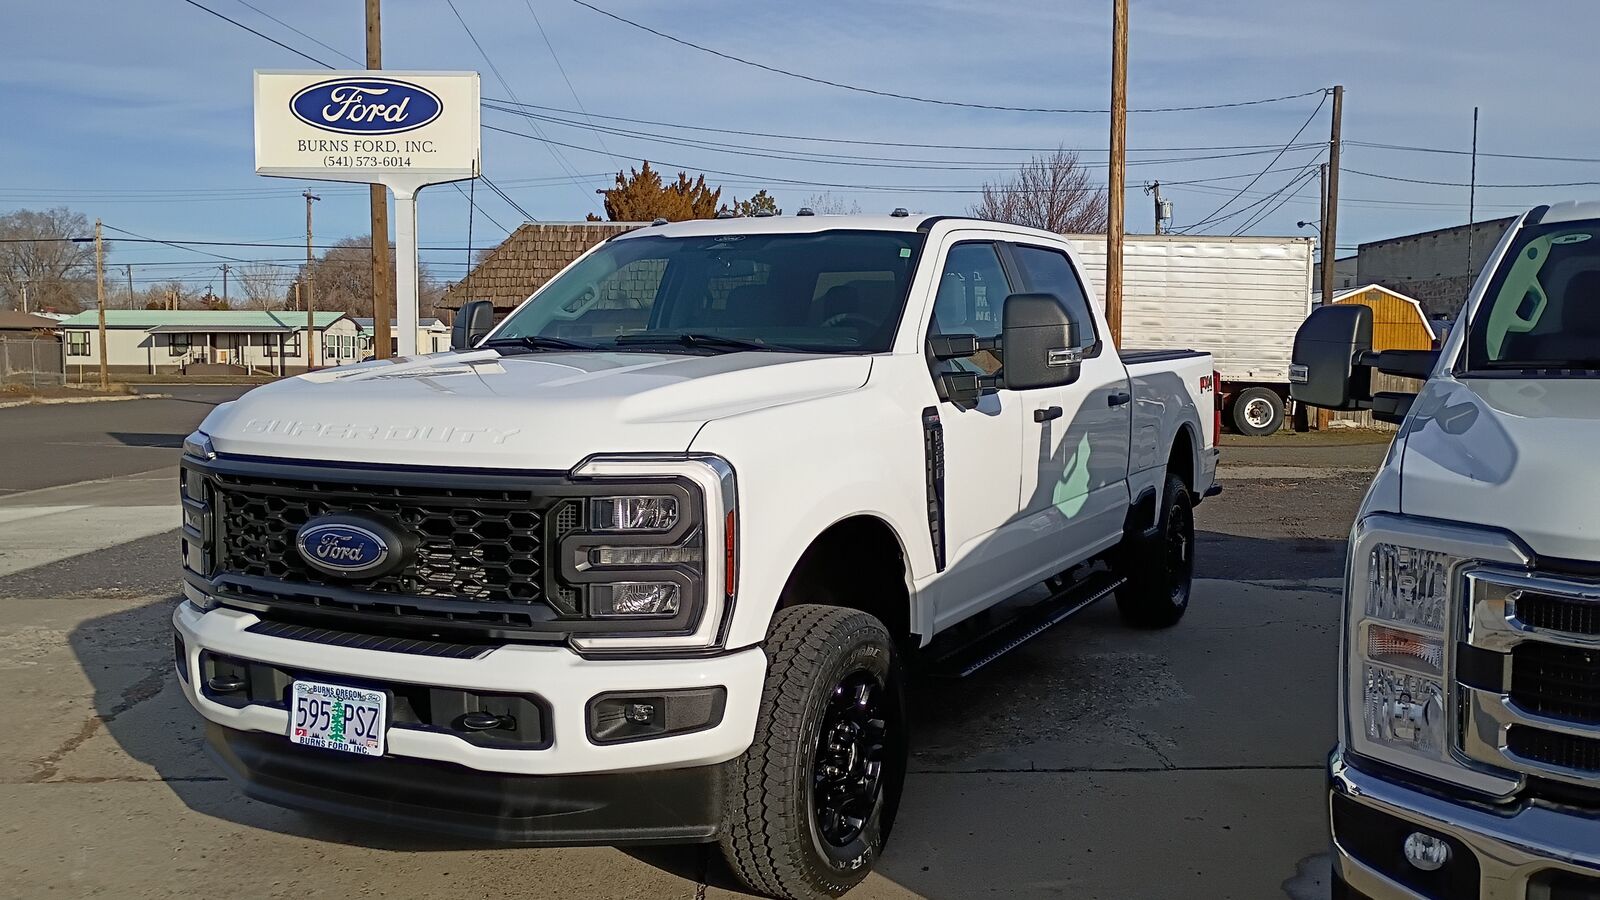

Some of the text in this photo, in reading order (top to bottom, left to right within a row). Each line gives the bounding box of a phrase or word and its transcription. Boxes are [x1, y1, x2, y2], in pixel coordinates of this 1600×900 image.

[322, 86, 411, 123] Ford
[298, 139, 437, 153] BURNS FORD, INC.
[323, 156, 411, 168] (541) 573-6014
[241, 418, 521, 445] SUPER DUTY
[316, 533, 365, 561] Ford
[312, 685, 362, 699] BURNS OREGON
[297, 697, 378, 739] 595 PSZ
[300, 737, 370, 755] BURNS FORD, INC.
